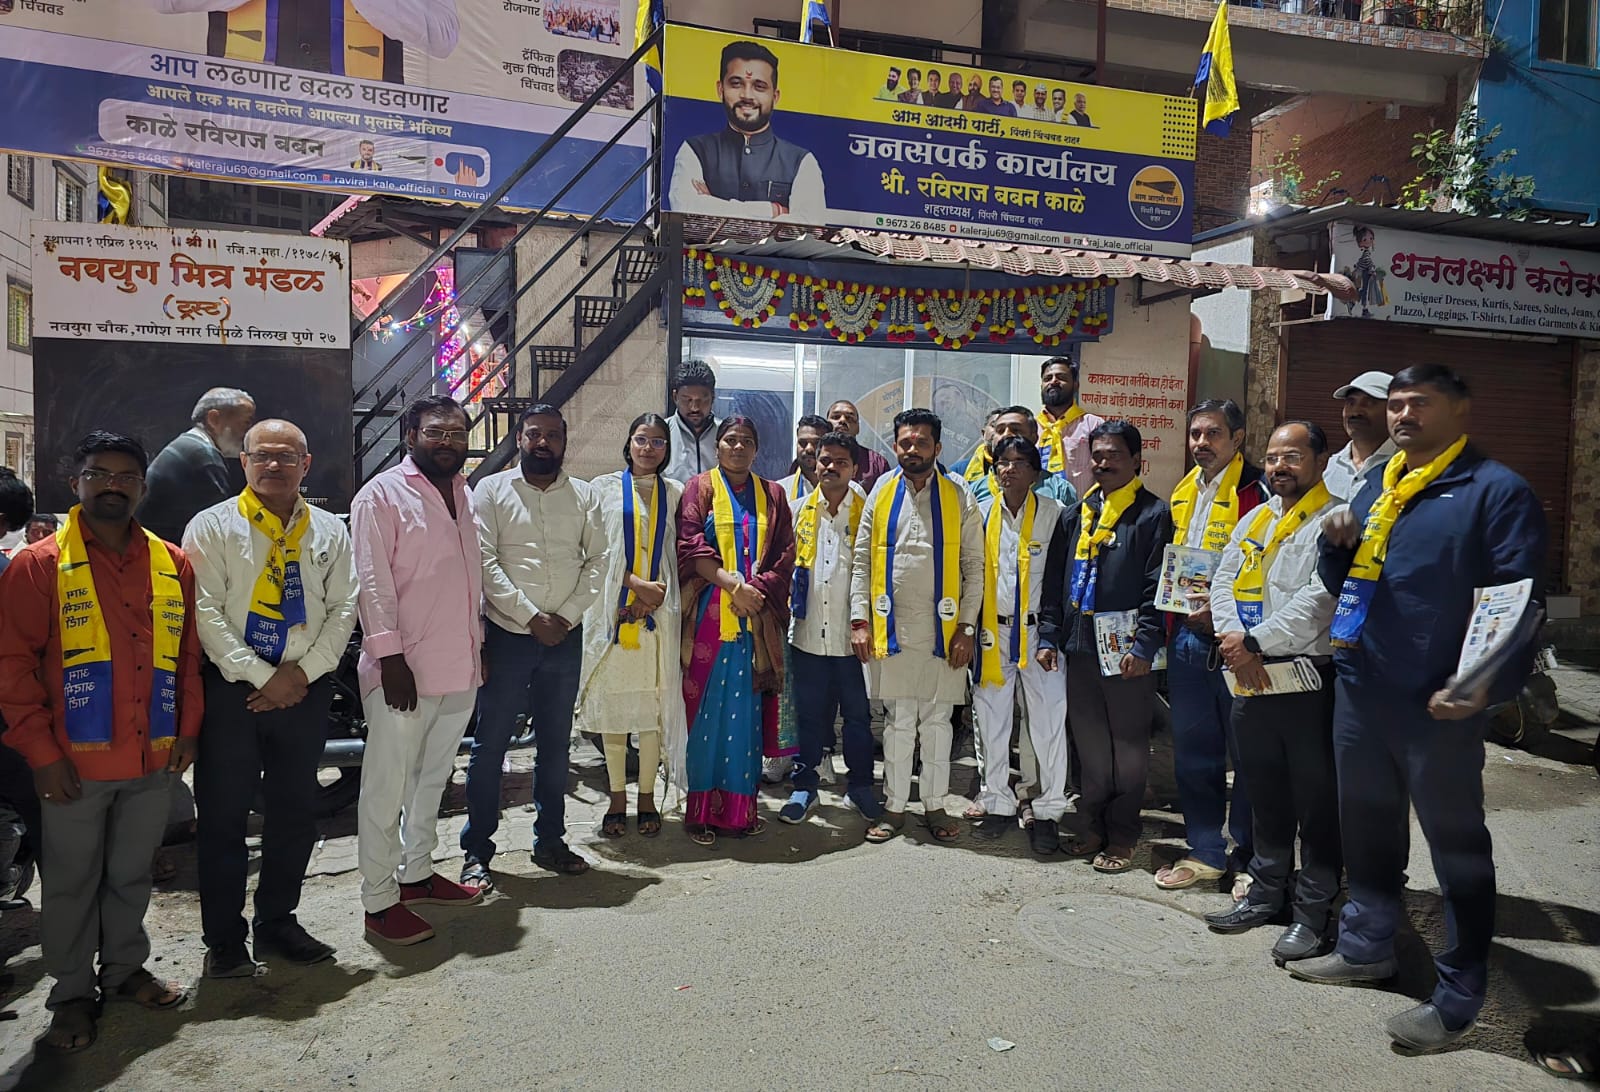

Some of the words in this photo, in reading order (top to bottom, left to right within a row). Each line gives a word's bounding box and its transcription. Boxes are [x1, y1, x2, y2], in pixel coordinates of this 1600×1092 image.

[502, 61, 525, 76] मुक्त
[527, 62, 555, 79] पिंपरी
[150, 53, 199, 79] आप
[205, 61, 292, 92] लढणार
[298, 75, 355, 100] बदल
[360, 84, 450, 114] घडवणार
[520, 76, 555, 93] चिंचवड
[146, 84, 192, 103] आपले
[195, 91, 223, 107] एक
[226, 96, 251, 112] मत
[307, 106, 361, 127] आपल्या
[363, 113, 406, 133] मुलांचे
[408, 118, 453, 138] भविष्य
[892, 109, 922, 125] आम
[925, 113, 968, 130] आदमी
[971, 118, 1006, 137] पार्टी,
[125, 112, 178, 139] काळे
[184, 118, 268, 151] रविराज
[273, 134, 326, 158] बबन
[187, 156, 318, 182] kaleraju69@gmail.com
[848, 132, 988, 170] जनसंपर्क
[995, 150, 1118, 187] कार्यालय
[880, 167, 910, 195] श्री.
[917, 171, 990, 203] रविराज
[994, 185, 1040, 209] बबन
[1044, 186, 1086, 214] काळे
[923, 203, 975, 220] शहराध्यक्ष,
[95, 234, 125, 249] एप्रिल
[128, 238, 159, 250] १९९५
[185, 232, 202, 248] श्री
[885, 218, 908, 229] 9673
[909, 220, 921, 230] 26
[923, 221, 946, 232] 8485
[960, 224, 1060, 243] kaleraju69@gmail.com
[58, 256, 160, 293] नवयुग
[169, 252, 235, 290] मित्र
[243, 257, 325, 293] मंडळ
[1390, 251, 1518, 292] धनलक्ष्मी
[162, 293, 232, 321] (ट्रस्ट)
[1394, 305, 1426, 319] Plazzo,
[1428, 307, 1469, 321] Leggings,
[1470, 310, 1508, 325] T-Shirts,
[1509, 314, 1537, 327] Ladies
[1538, 317, 1578, 330] Garments
[1579, 321, 1587, 331] &
[1404, 291, 1443, 305] Designer
[1482, 297, 1512, 311] Kurtis,
[1571, 306, 1596, 319] Jeans,
[48, 321, 92, 336] नवयुग
[175, 326, 202, 338] नगर
[246, 326, 287, 341] निलख
[292, 328, 313, 345] पुणे
[319, 332, 336, 344] २७
[251, 630, 280, 645] आदमी
[258, 619, 277, 632] आम
